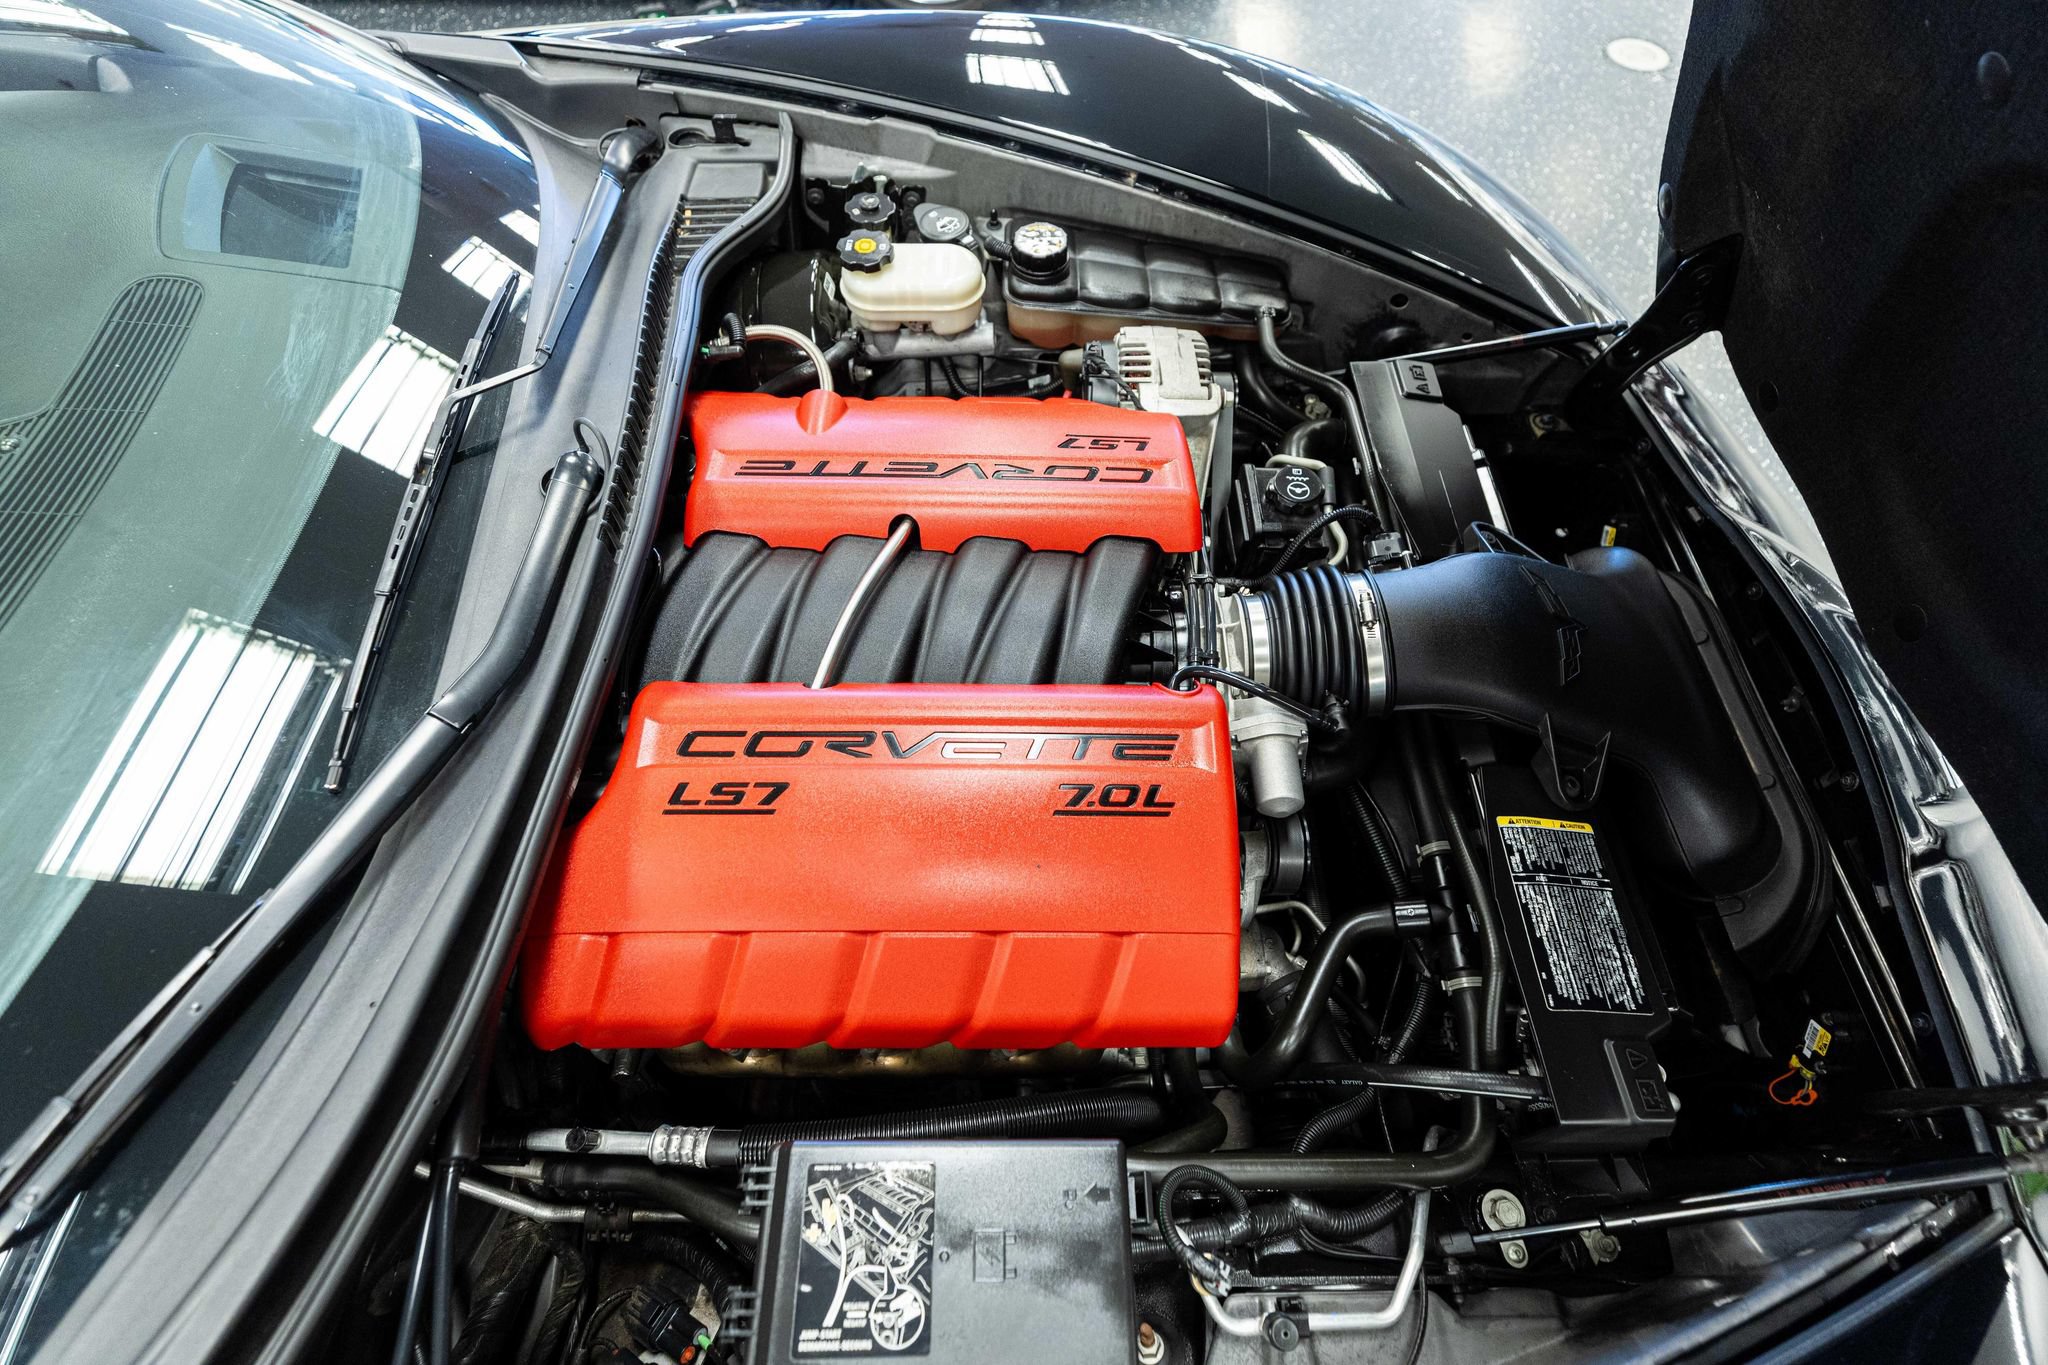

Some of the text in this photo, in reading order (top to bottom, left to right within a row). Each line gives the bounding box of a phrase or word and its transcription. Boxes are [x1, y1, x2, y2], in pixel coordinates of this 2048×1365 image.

[1057, 437, 1149, 451] LS7
[735, 460, 1154, 484] CORVETTE
[675, 730, 1180, 761] CORVETTE
[668, 782, 791, 807] LS7
[1058, 784, 1177, 808] 7.0L
[1515, 818, 1542, 826] ATTENTION
